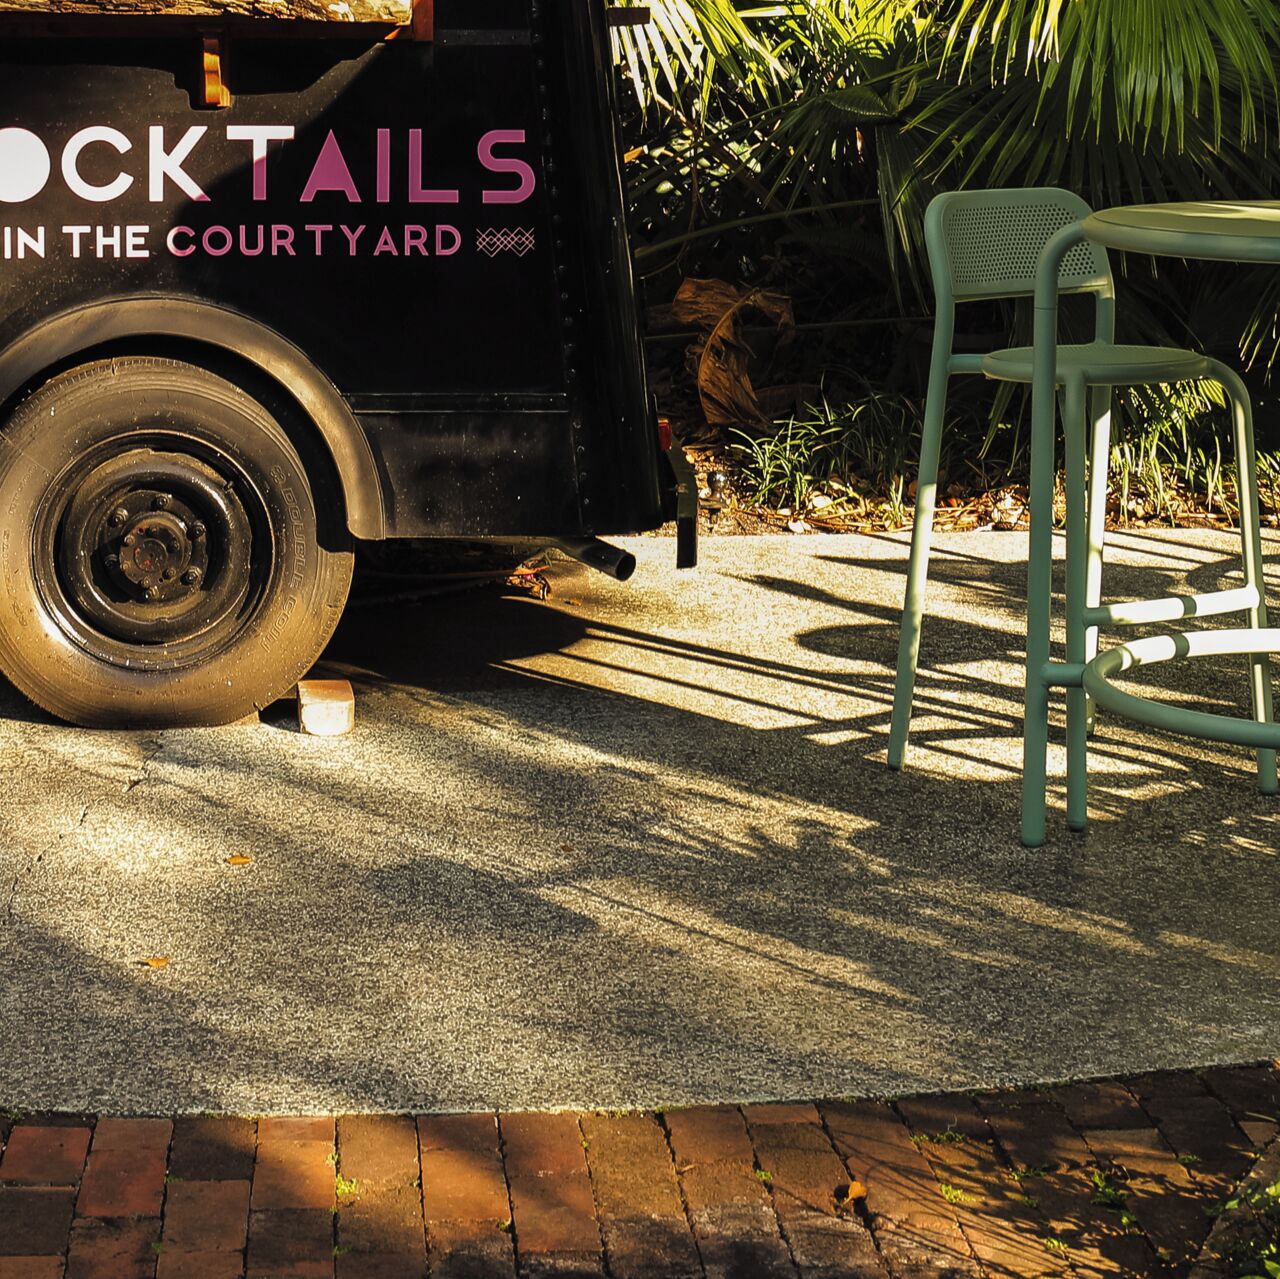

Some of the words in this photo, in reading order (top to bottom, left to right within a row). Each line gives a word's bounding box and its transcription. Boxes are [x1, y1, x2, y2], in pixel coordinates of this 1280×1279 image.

[4, 225, 45, 260] IN
[62, 225, 150, 259] THE
[167, 225, 462, 257] COURTYARD
[282, 488, 306, 589] DOUBLE
